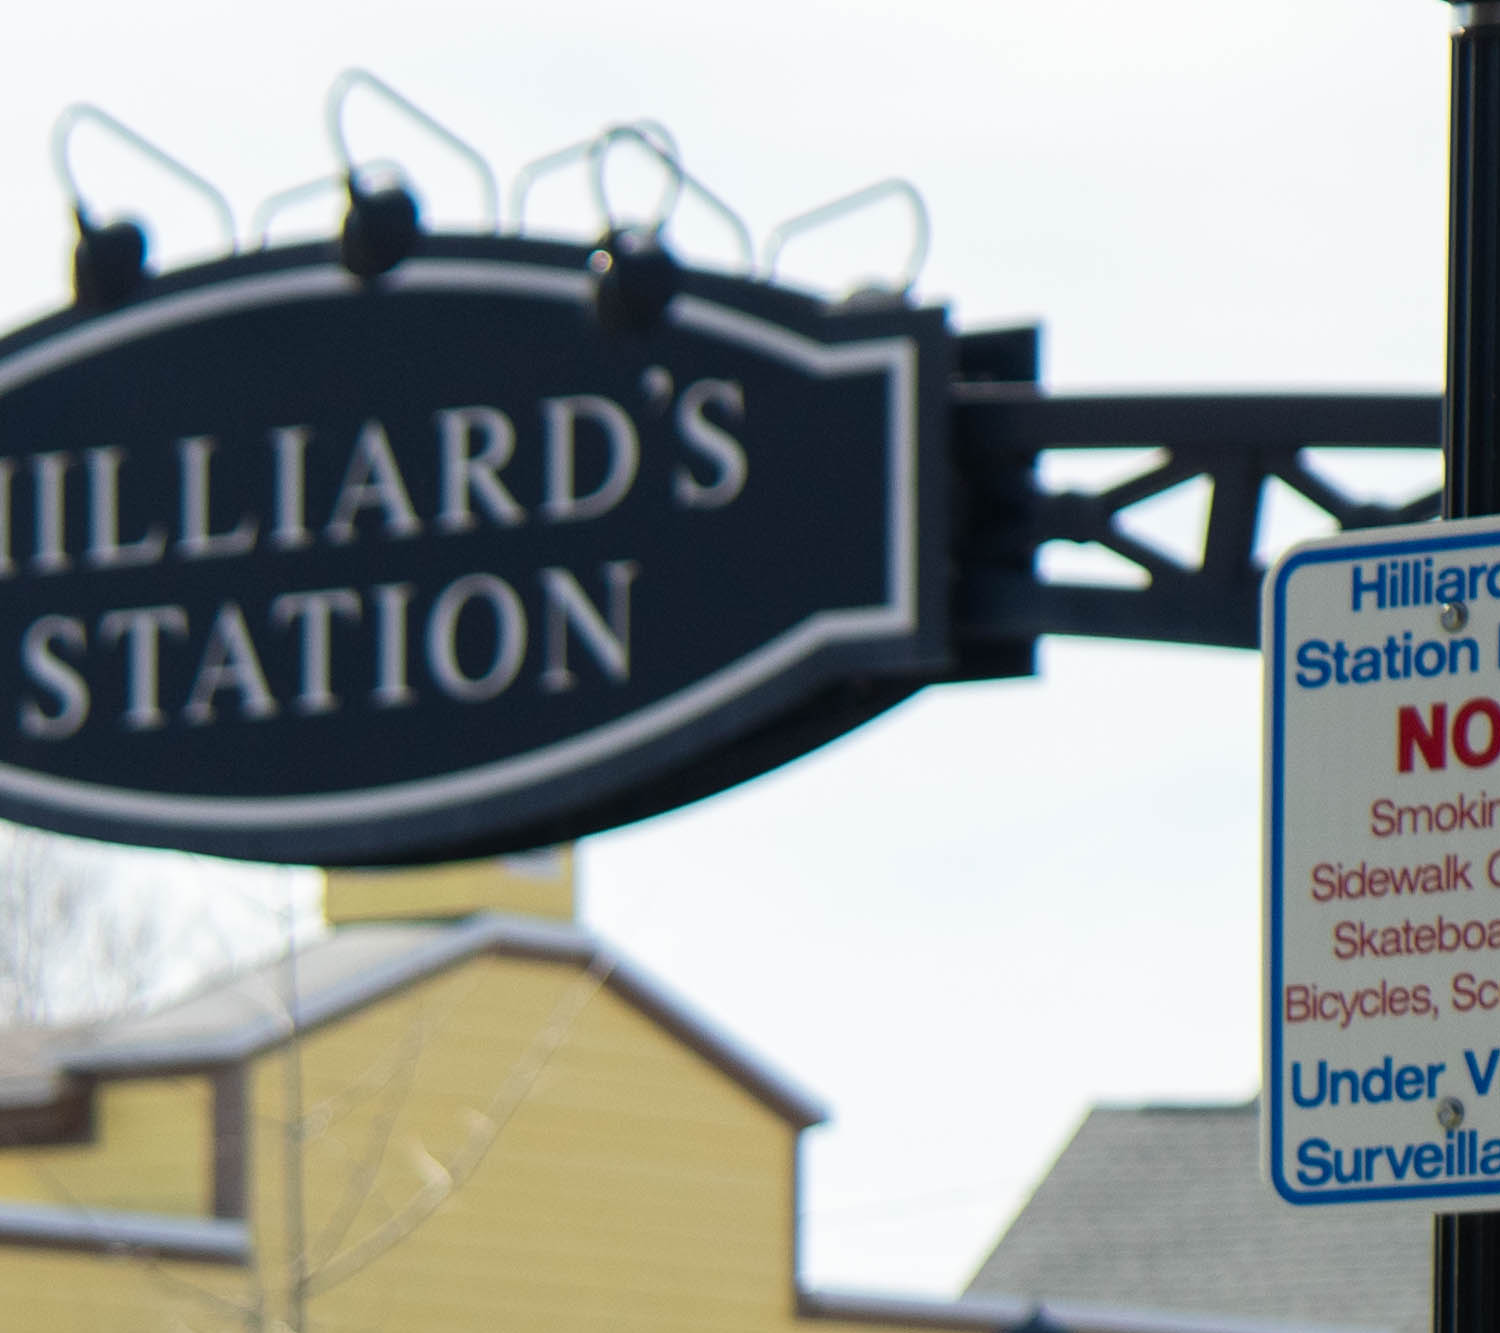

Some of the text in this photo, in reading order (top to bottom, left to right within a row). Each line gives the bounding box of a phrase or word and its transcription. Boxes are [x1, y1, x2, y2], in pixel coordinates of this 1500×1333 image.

[18, 560, 640, 741] STATION
[1296, 631, 1479, 689] Station
[1311, 854, 1473, 902] Sidewalk
[1285, 980, 1439, 1030] Bicycles,
[1292, 1055, 1446, 1109] Under
